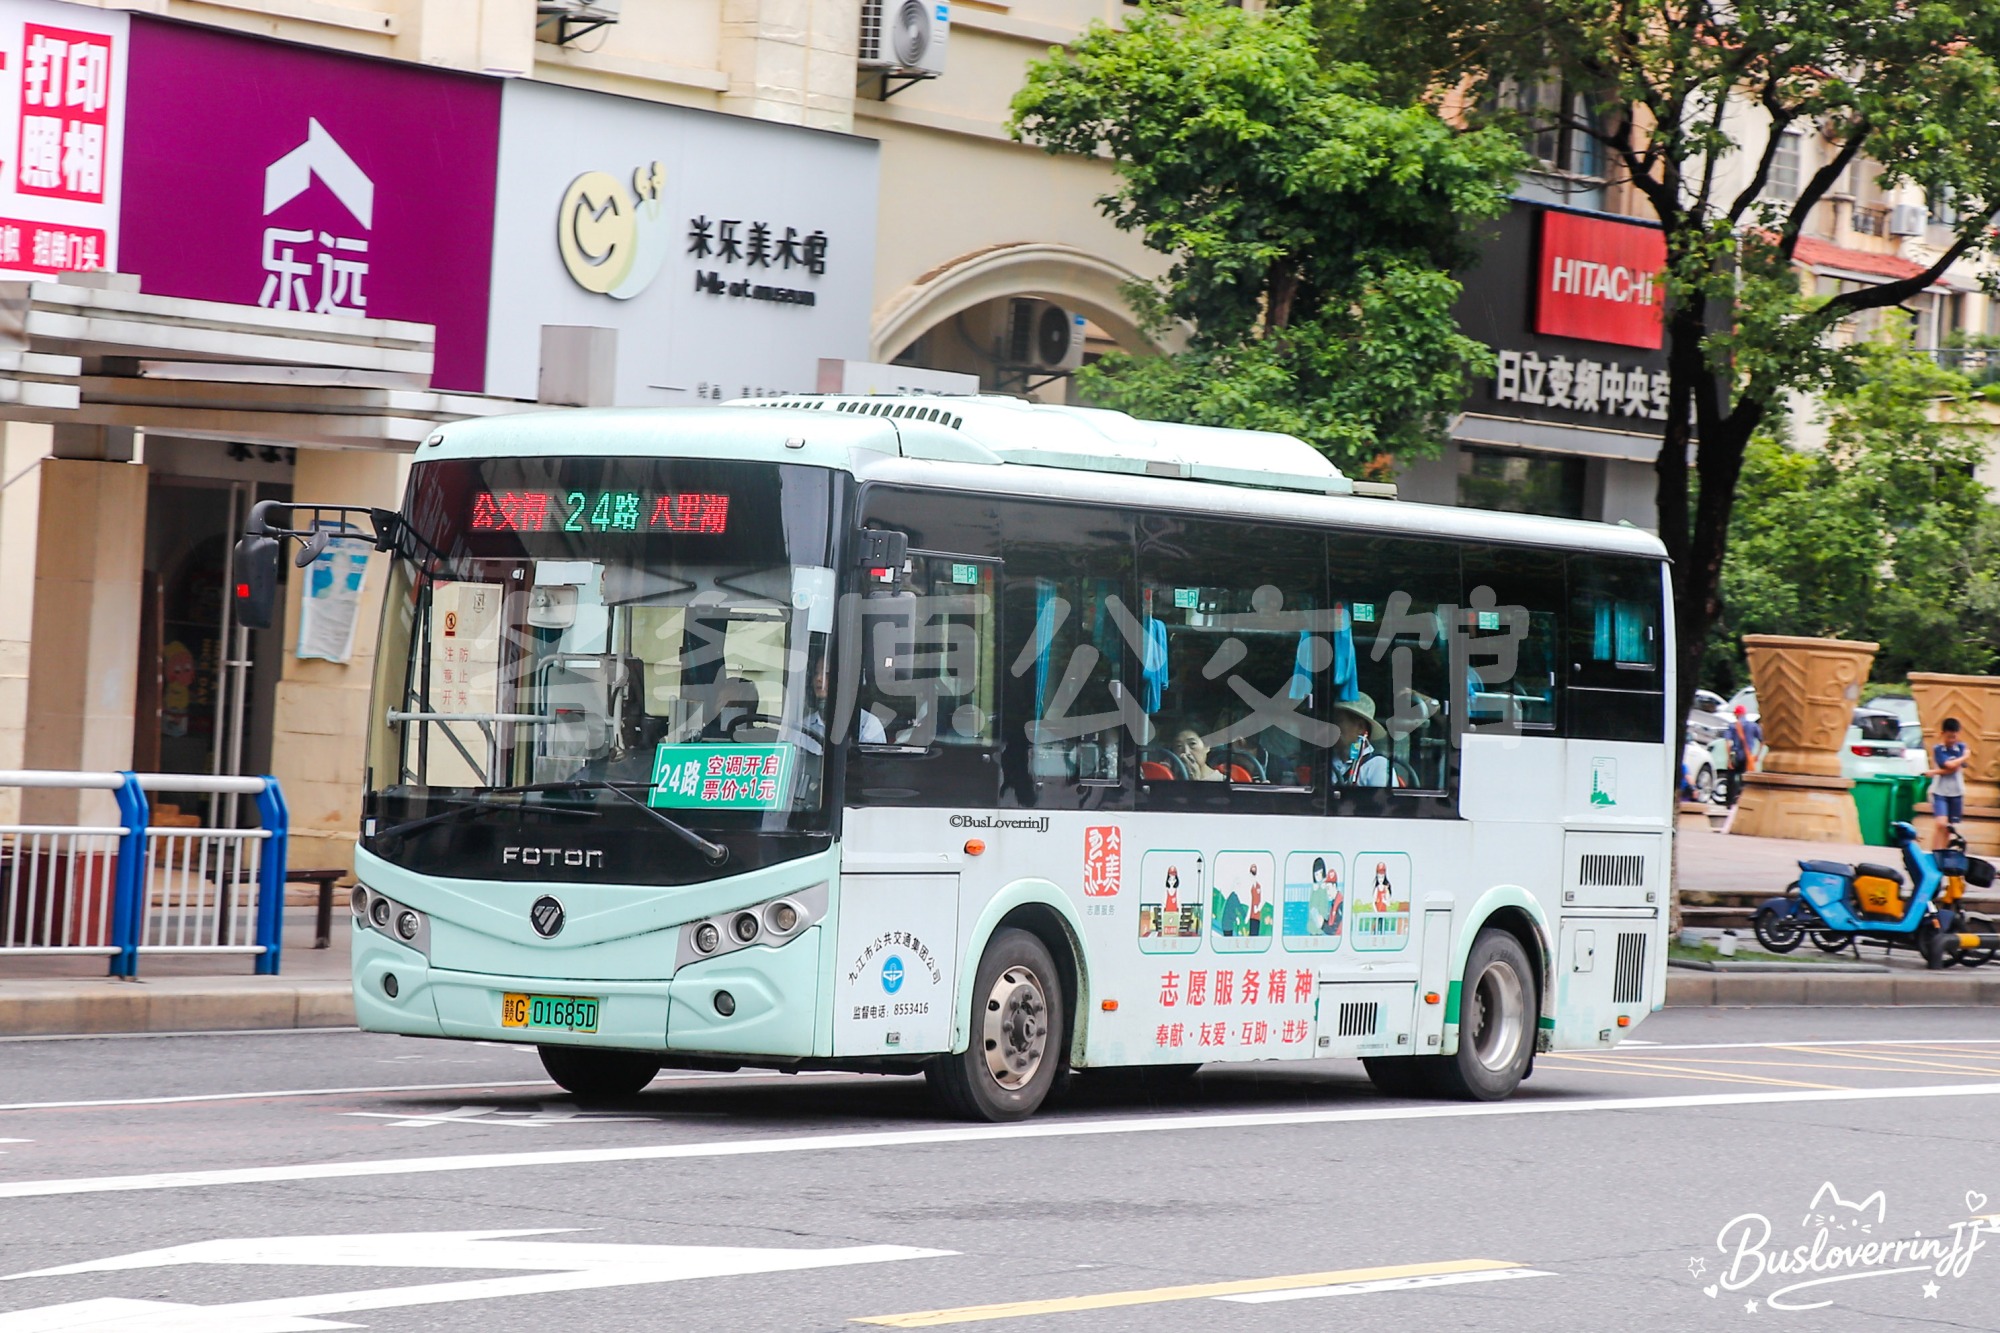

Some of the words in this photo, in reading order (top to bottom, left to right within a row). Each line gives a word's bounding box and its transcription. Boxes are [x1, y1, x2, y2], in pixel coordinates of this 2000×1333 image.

[25, 34, 108, 112] 打印
[20, 115, 104, 193] 照相
[687, 214, 828, 275] 米乐美术馆
[258, 227, 369, 318] 乐远
[1552, 256, 1654, 306] HITACHI
[1498, 349, 1697, 424] 日立变频中央空
[564, 492, 640, 532] 24路
[657, 760, 701, 797] 24路
[702, 776, 776, 801] 票价+1元
[706, 755, 780, 777] 空调开启
[503, 847, 603, 868] FOTON
[848, 931, 942, 986] 九江市公共交通集团公司
[893, 1002, 929, 1016] 8553416
[1158, 968, 1313, 1007] 志愿服务精神
